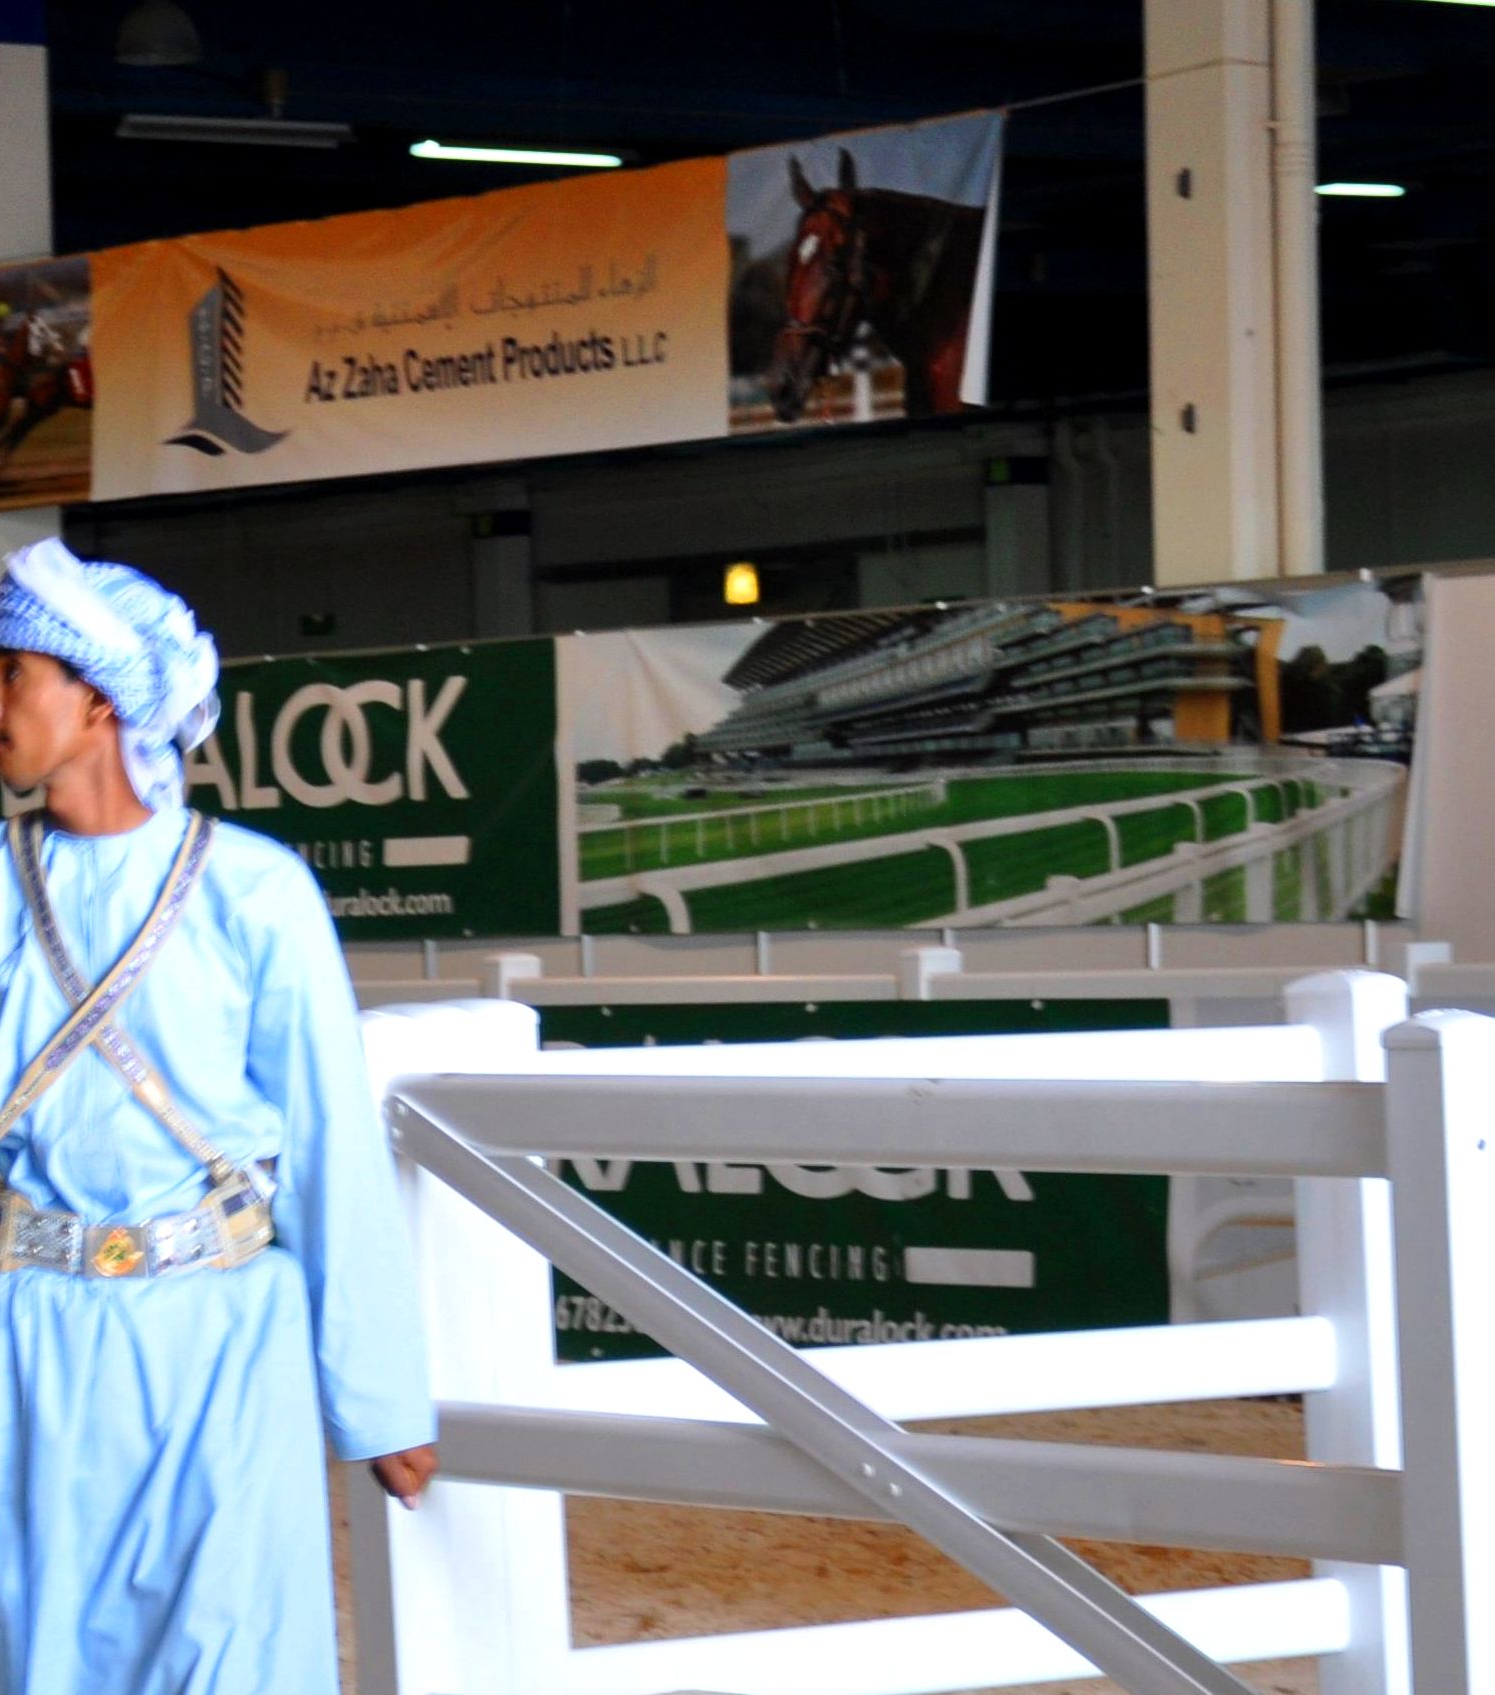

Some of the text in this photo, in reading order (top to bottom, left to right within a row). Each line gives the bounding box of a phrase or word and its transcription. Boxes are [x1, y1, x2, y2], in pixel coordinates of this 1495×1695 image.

[305, 359, 337, 402] Az
[342, 353, 399, 399] Zaha
[405, 340, 497, 393] Cement
[501, 325, 615, 382] Products
[324, 886, 453, 917] uralock.com
[745, 1240, 889, 1283] FENCING
